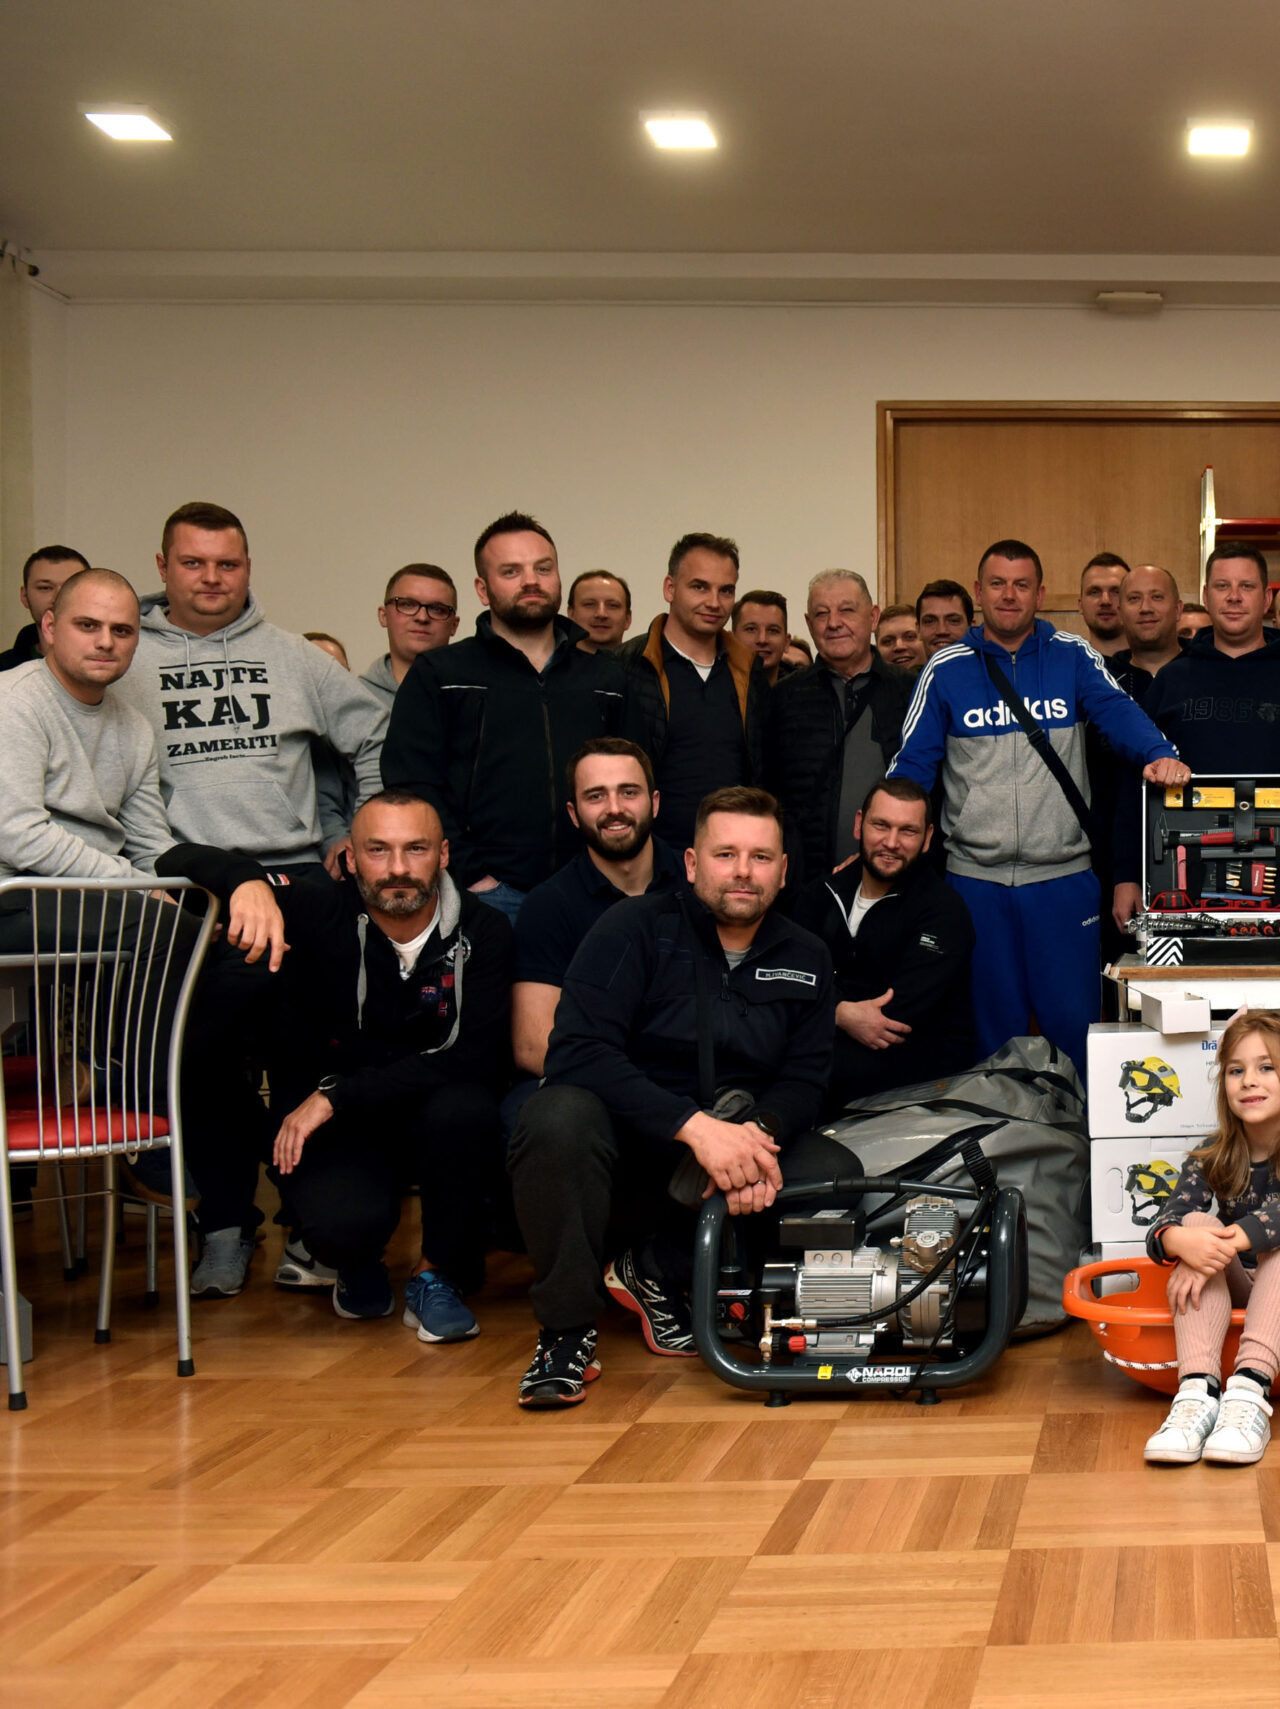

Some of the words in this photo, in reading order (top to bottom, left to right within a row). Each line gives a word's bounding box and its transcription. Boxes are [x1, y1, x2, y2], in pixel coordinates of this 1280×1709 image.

[159, 666, 269, 691] NAJTE
[162, 693, 271, 731] KAJ
[166, 734, 278, 758] ZAMERITI
[862, 1366, 911, 1377] NARDI
